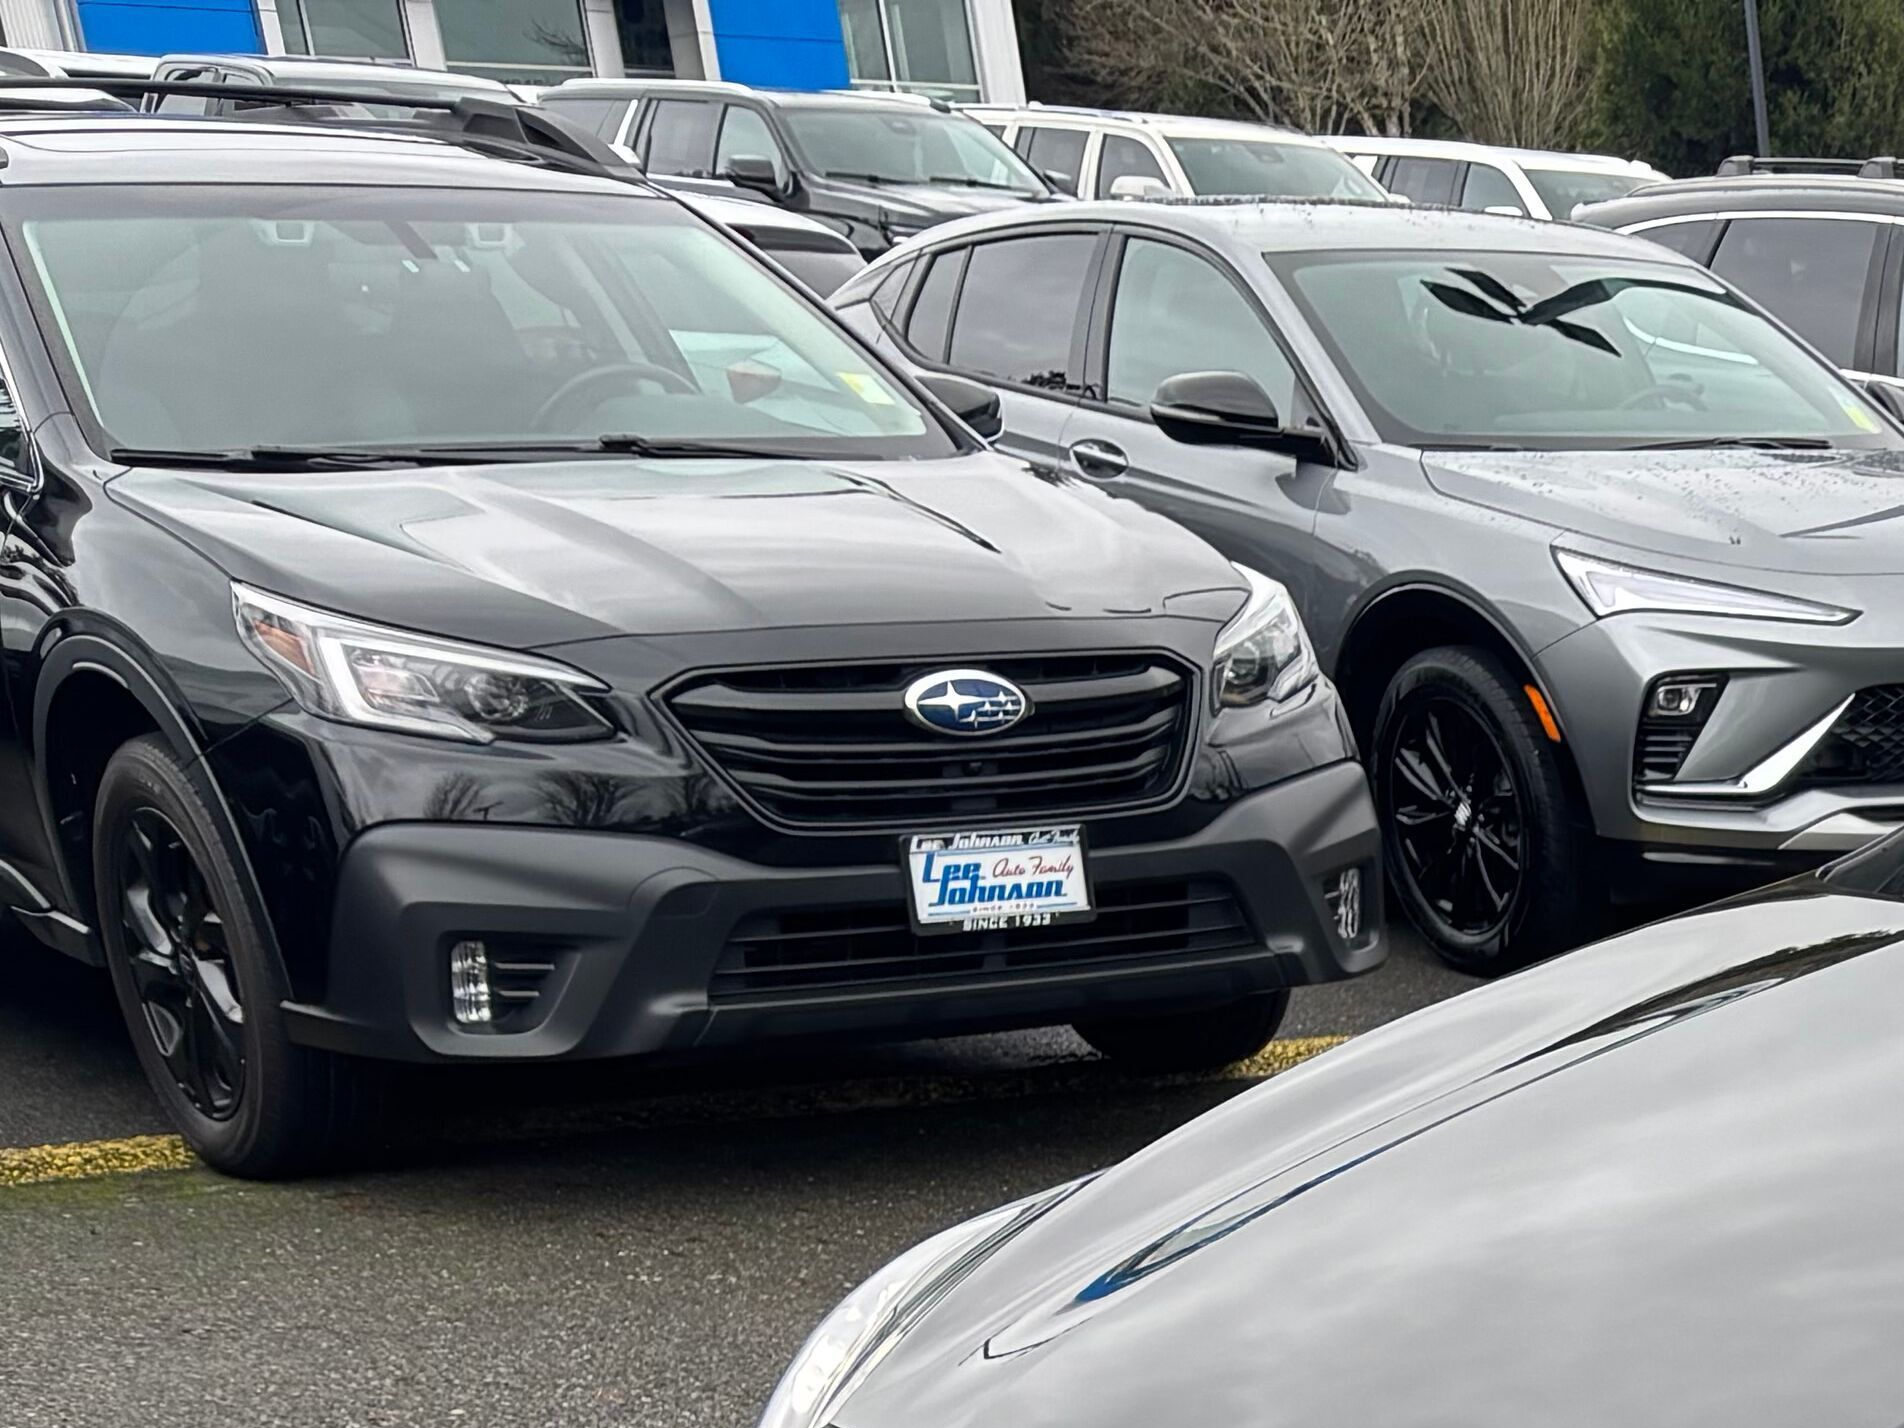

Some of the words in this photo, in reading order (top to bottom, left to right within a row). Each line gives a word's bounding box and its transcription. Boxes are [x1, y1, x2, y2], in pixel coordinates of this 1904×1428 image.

[922, 852, 984, 883] Lee
[992, 858, 1026, 878] Auto
[1029, 855, 1075, 879] Family
[928, 874, 1067, 907] Johnson
[963, 915, 1008, 931] SINCE
[1015, 913, 1052, 927] 1933
